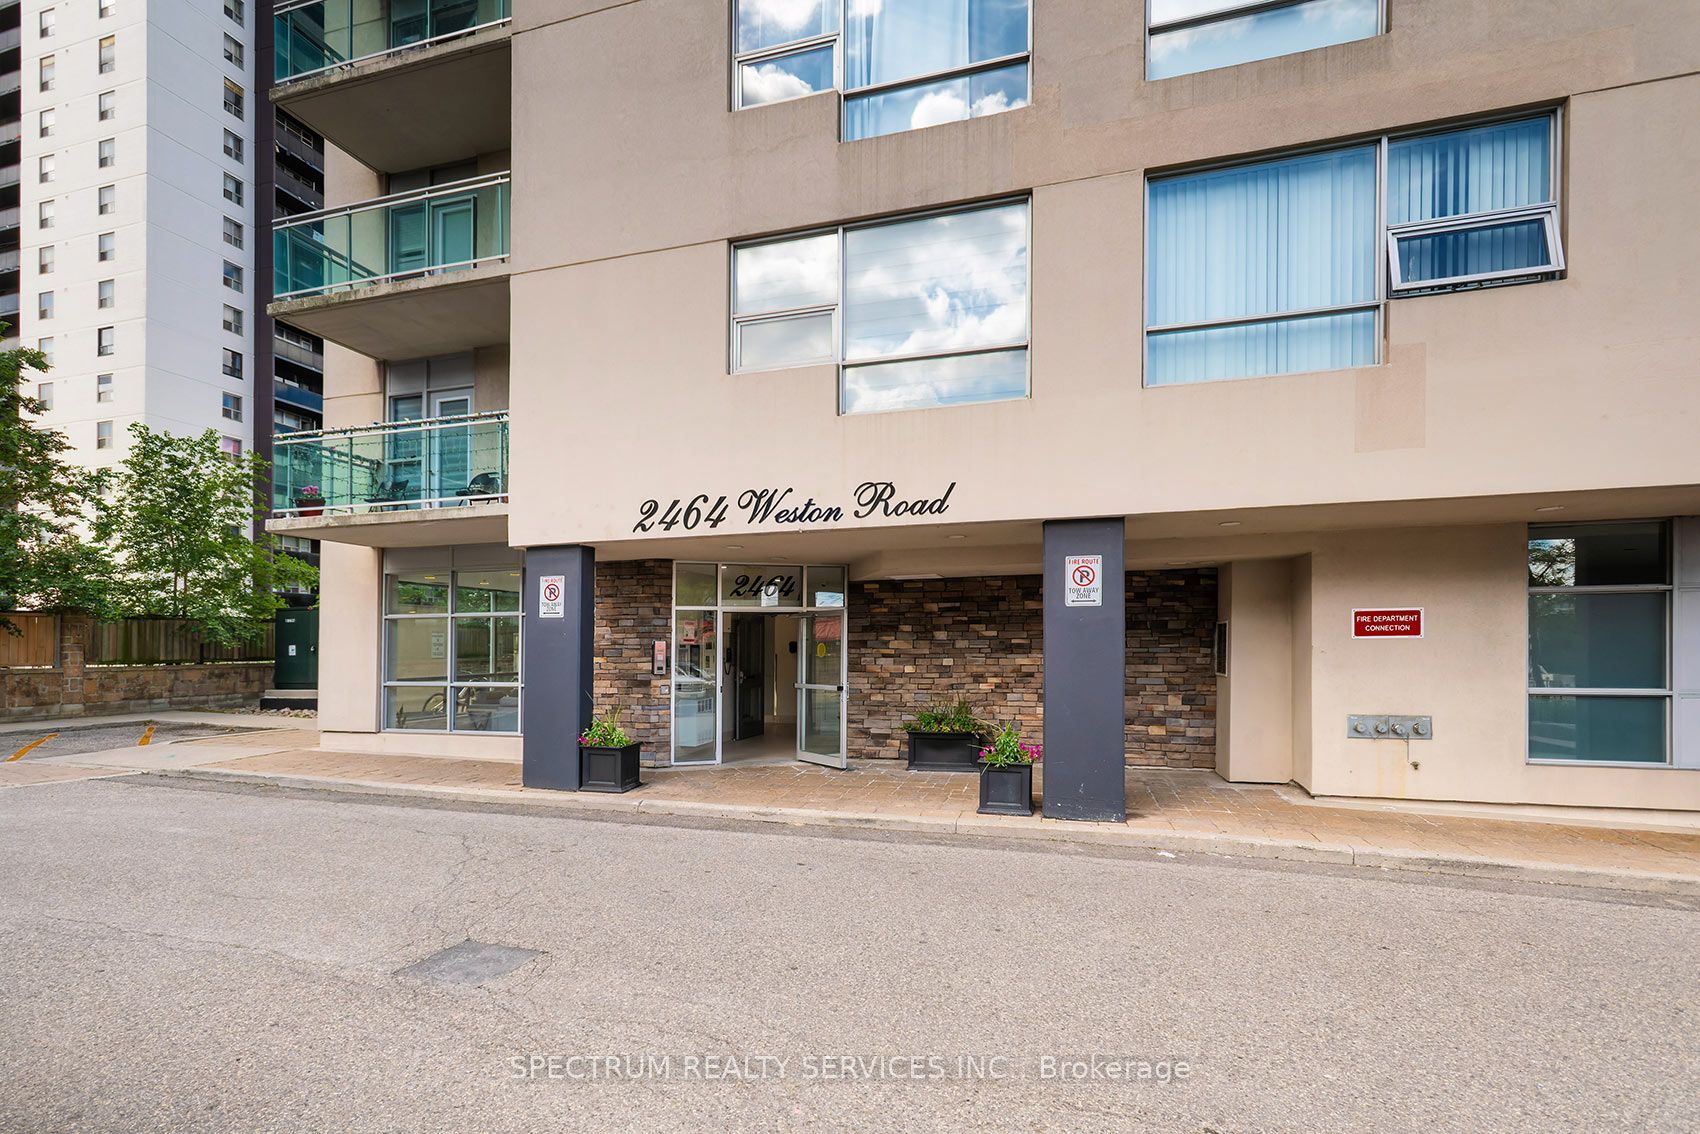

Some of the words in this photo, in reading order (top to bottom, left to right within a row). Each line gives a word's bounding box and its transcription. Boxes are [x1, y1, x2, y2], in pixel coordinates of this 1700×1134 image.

[633, 494, 729, 533] 2464
[737, 487, 843, 525] Weston
[854, 481, 957, 519] Road
[729, 574, 796, 597] 2464
[1373, 614, 1418, 622] DEPARTMENT
[1365, 624, 1411, 632] CONNECTION
